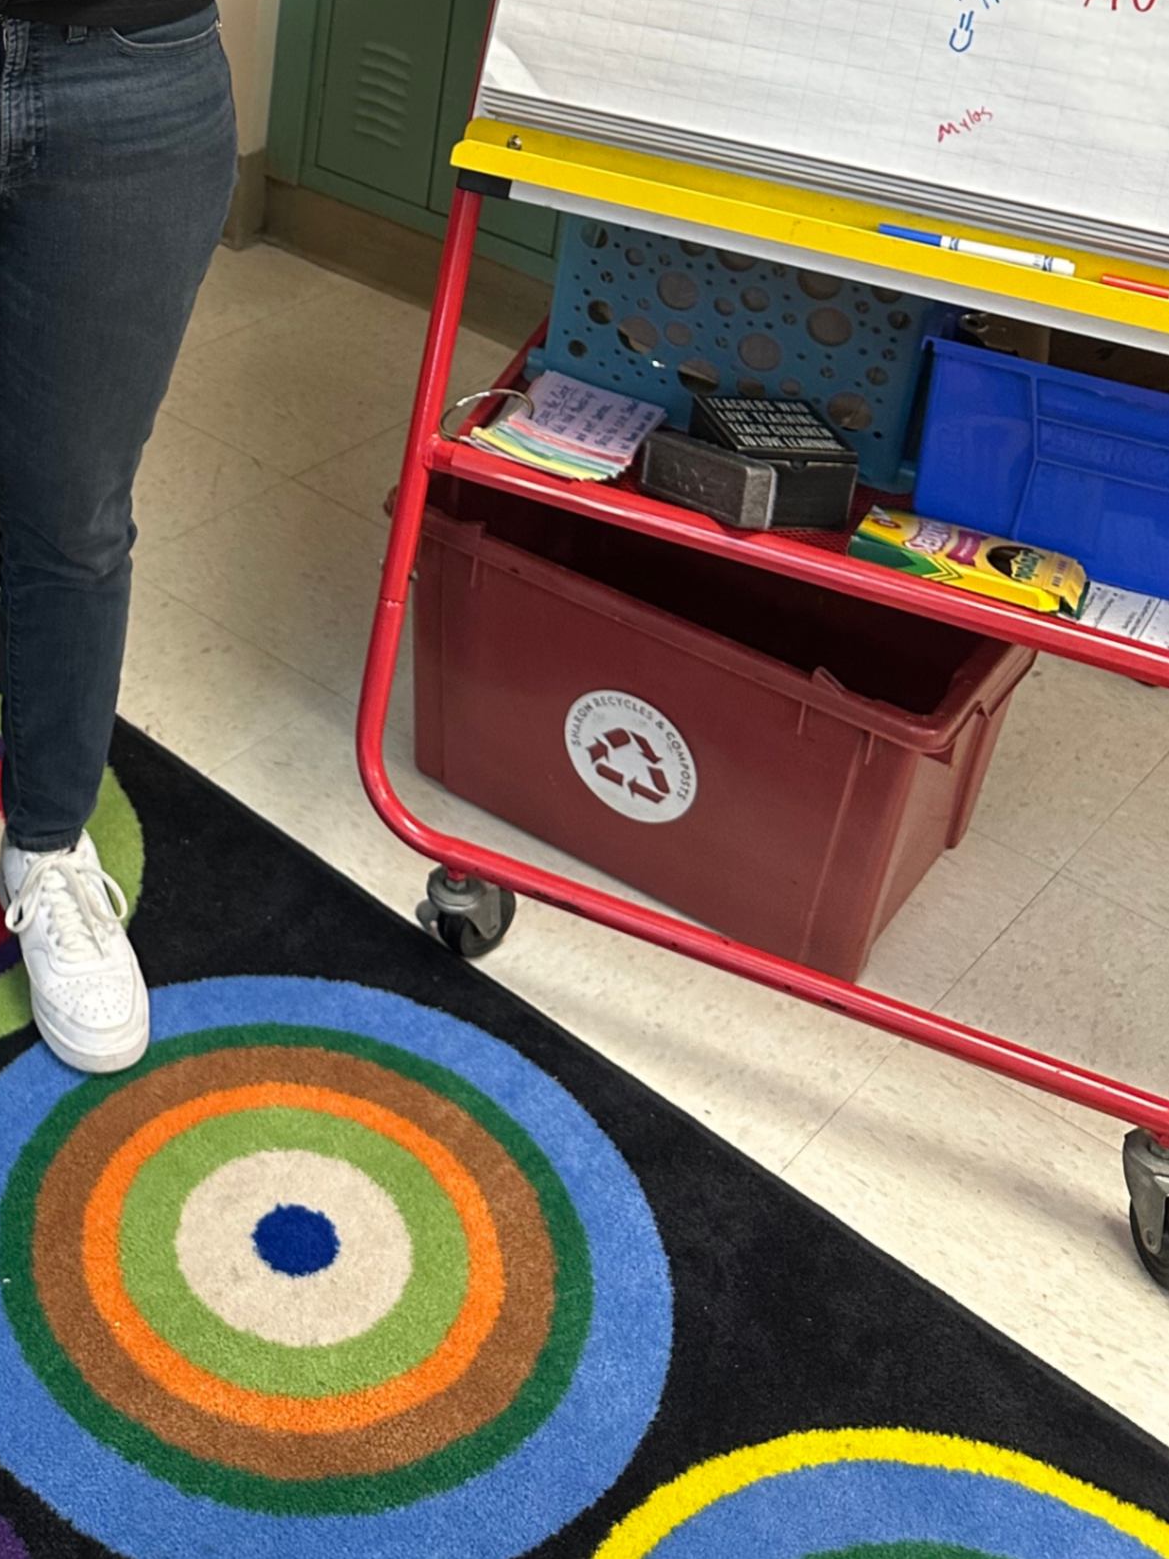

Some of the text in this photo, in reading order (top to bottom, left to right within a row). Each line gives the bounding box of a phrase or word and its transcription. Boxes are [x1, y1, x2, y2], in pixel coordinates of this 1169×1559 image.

[706, 396, 776, 411] TEACHERS
[570, 702, 593, 747] SHARON
[592, 695, 653, 720] RECYCLES
[665, 730, 692, 802] COMPOSTS
